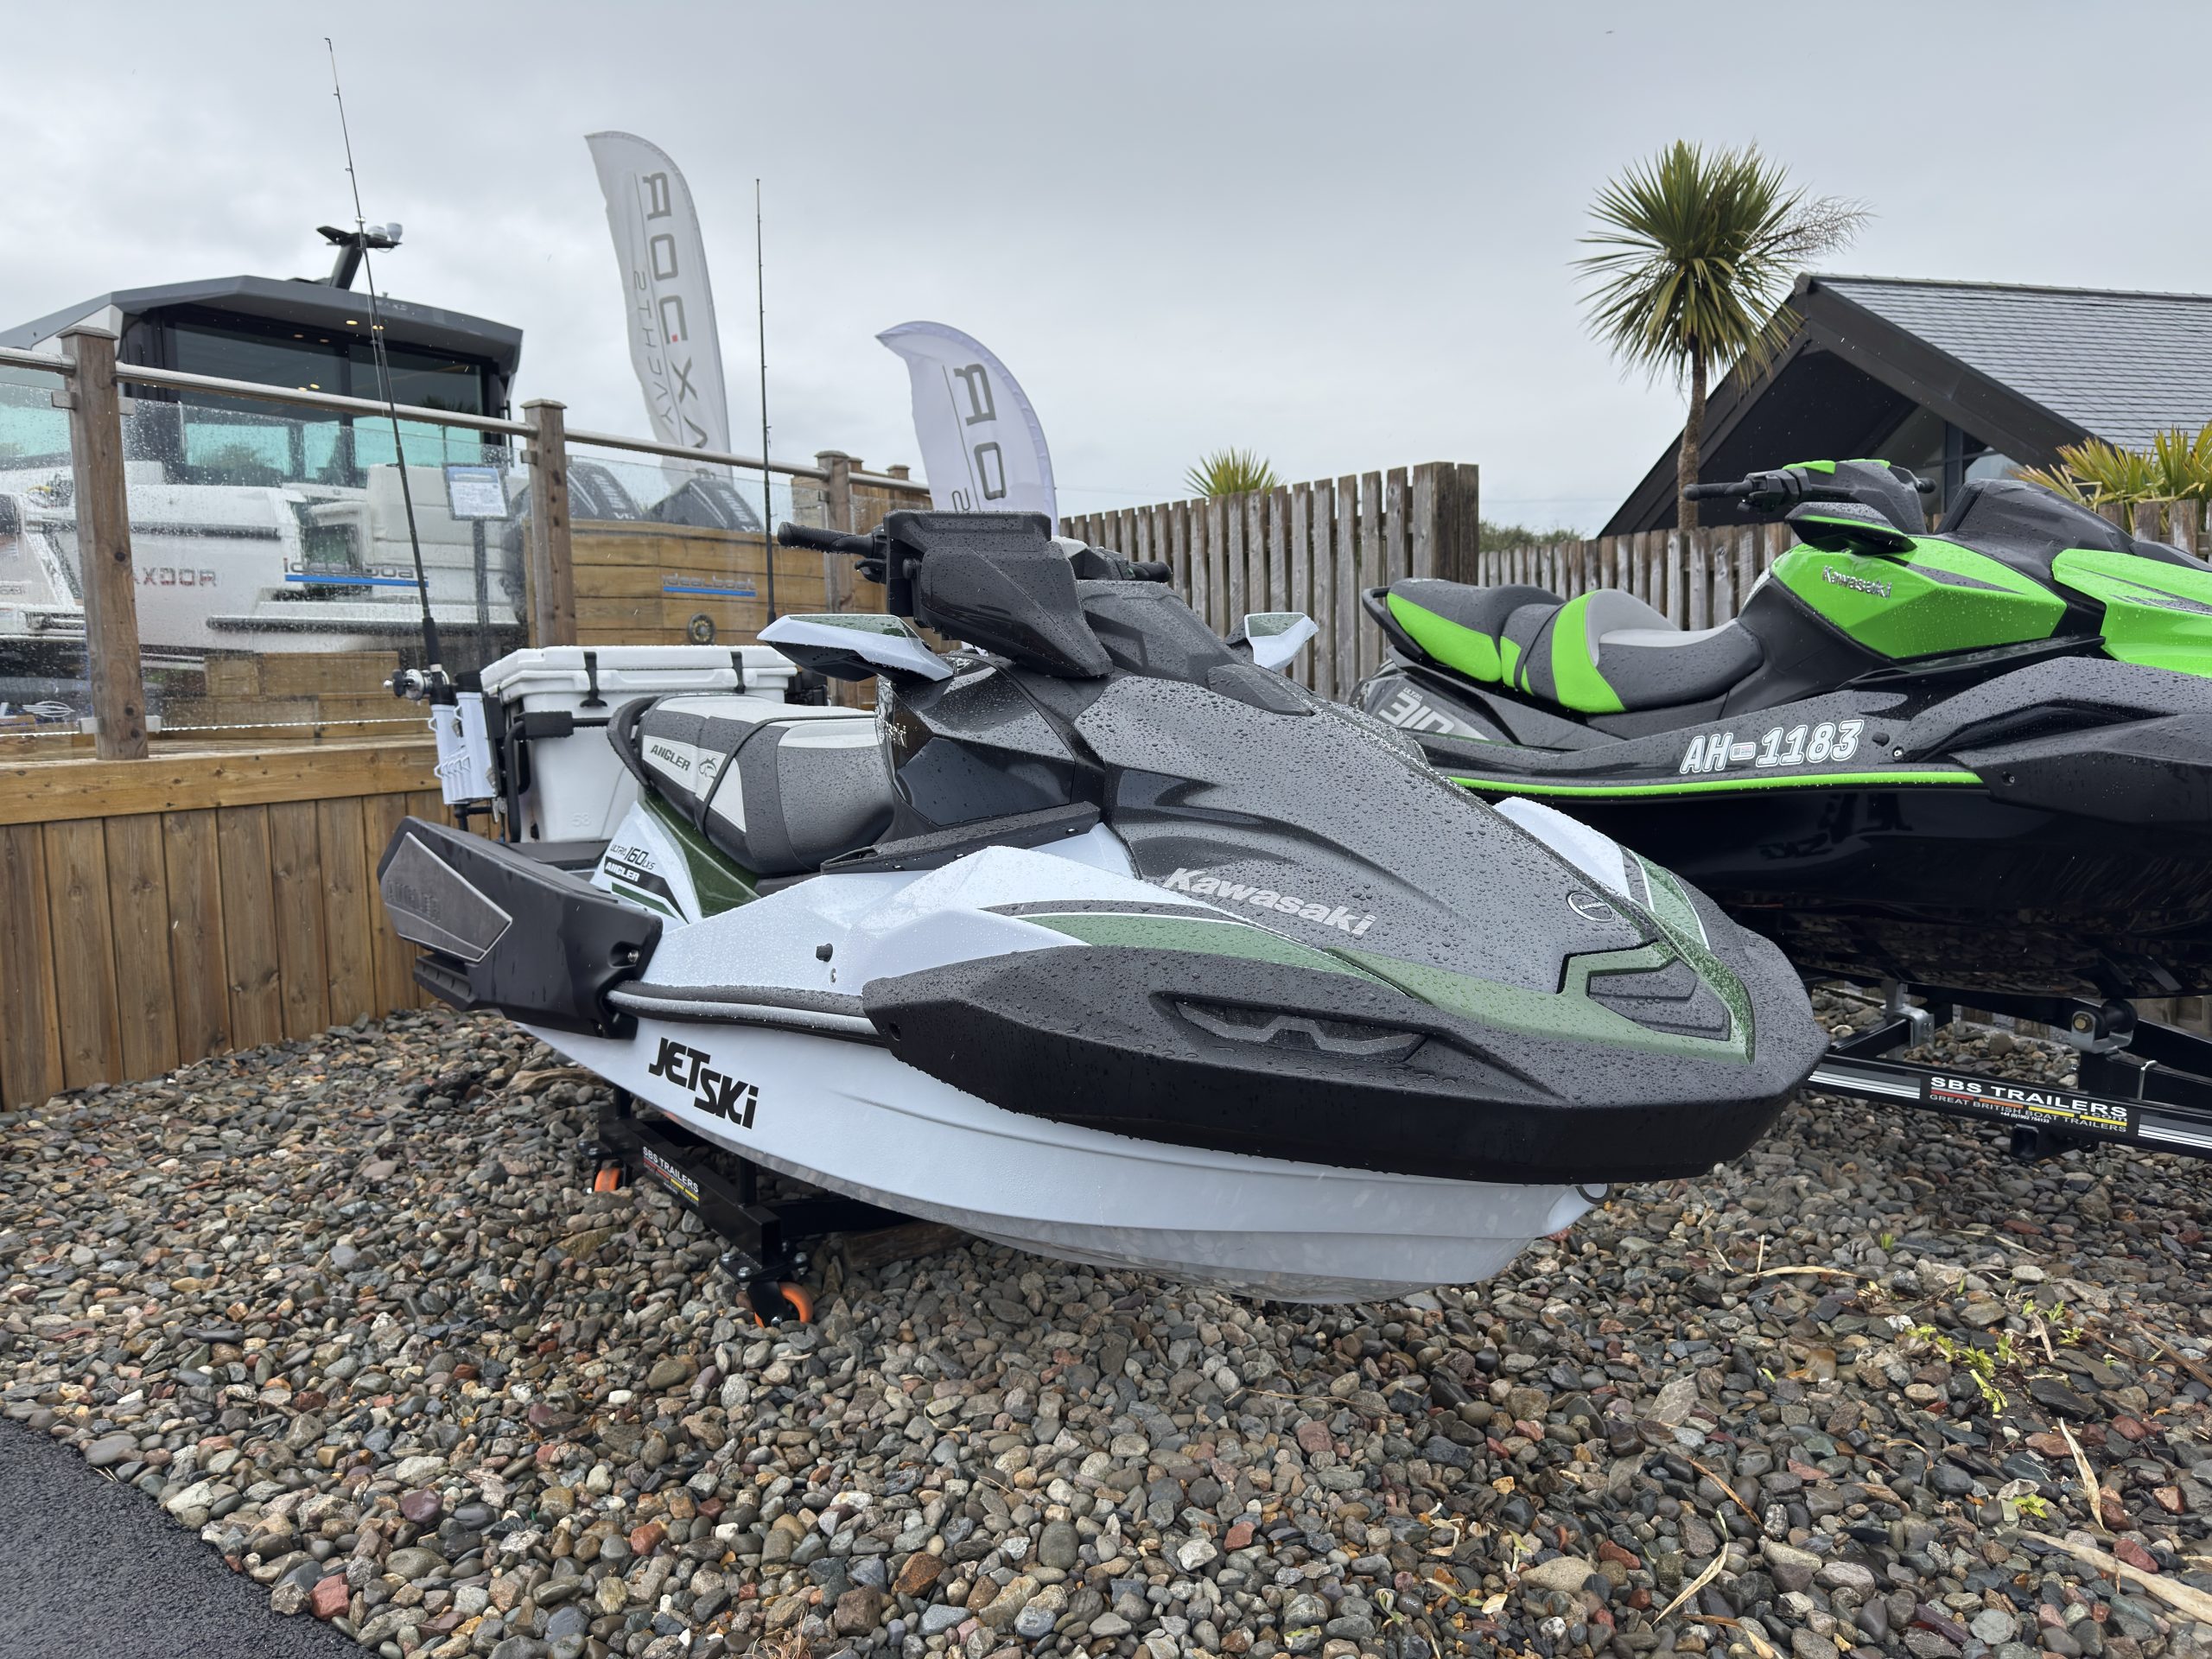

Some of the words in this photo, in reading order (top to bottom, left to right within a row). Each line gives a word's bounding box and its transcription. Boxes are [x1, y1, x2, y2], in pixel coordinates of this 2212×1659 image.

[132, 567, 217, 587] XDOR
[1821, 565, 1891, 598] Kawasaki
[1378, 691, 1454, 734] 310
[1403, 687, 1422, 702] ULTRA
[651, 745, 690, 771] ANGLER
[1680, 720, 1864, 773] AH-1183
[605, 861, 640, 882] ANGLER
[1162, 868, 1377, 936] Kawasaki
[648, 1037, 710, 1091] JET
[1929, 1094, 1969, 1106] GREAT
[1973, 1101, 2021, 1115] BRITISH
[2025, 1109, 2059, 1122] BOAT
[2063, 1116, 2126, 1133] TRAILERS
[1930, 1077, 1982, 1093] SBS
[1990, 1086, 2127, 1117] TRAILERS
[643, 1146, 658, 1163] SBS
[659, 1158, 699, 1192] TRAILERS
